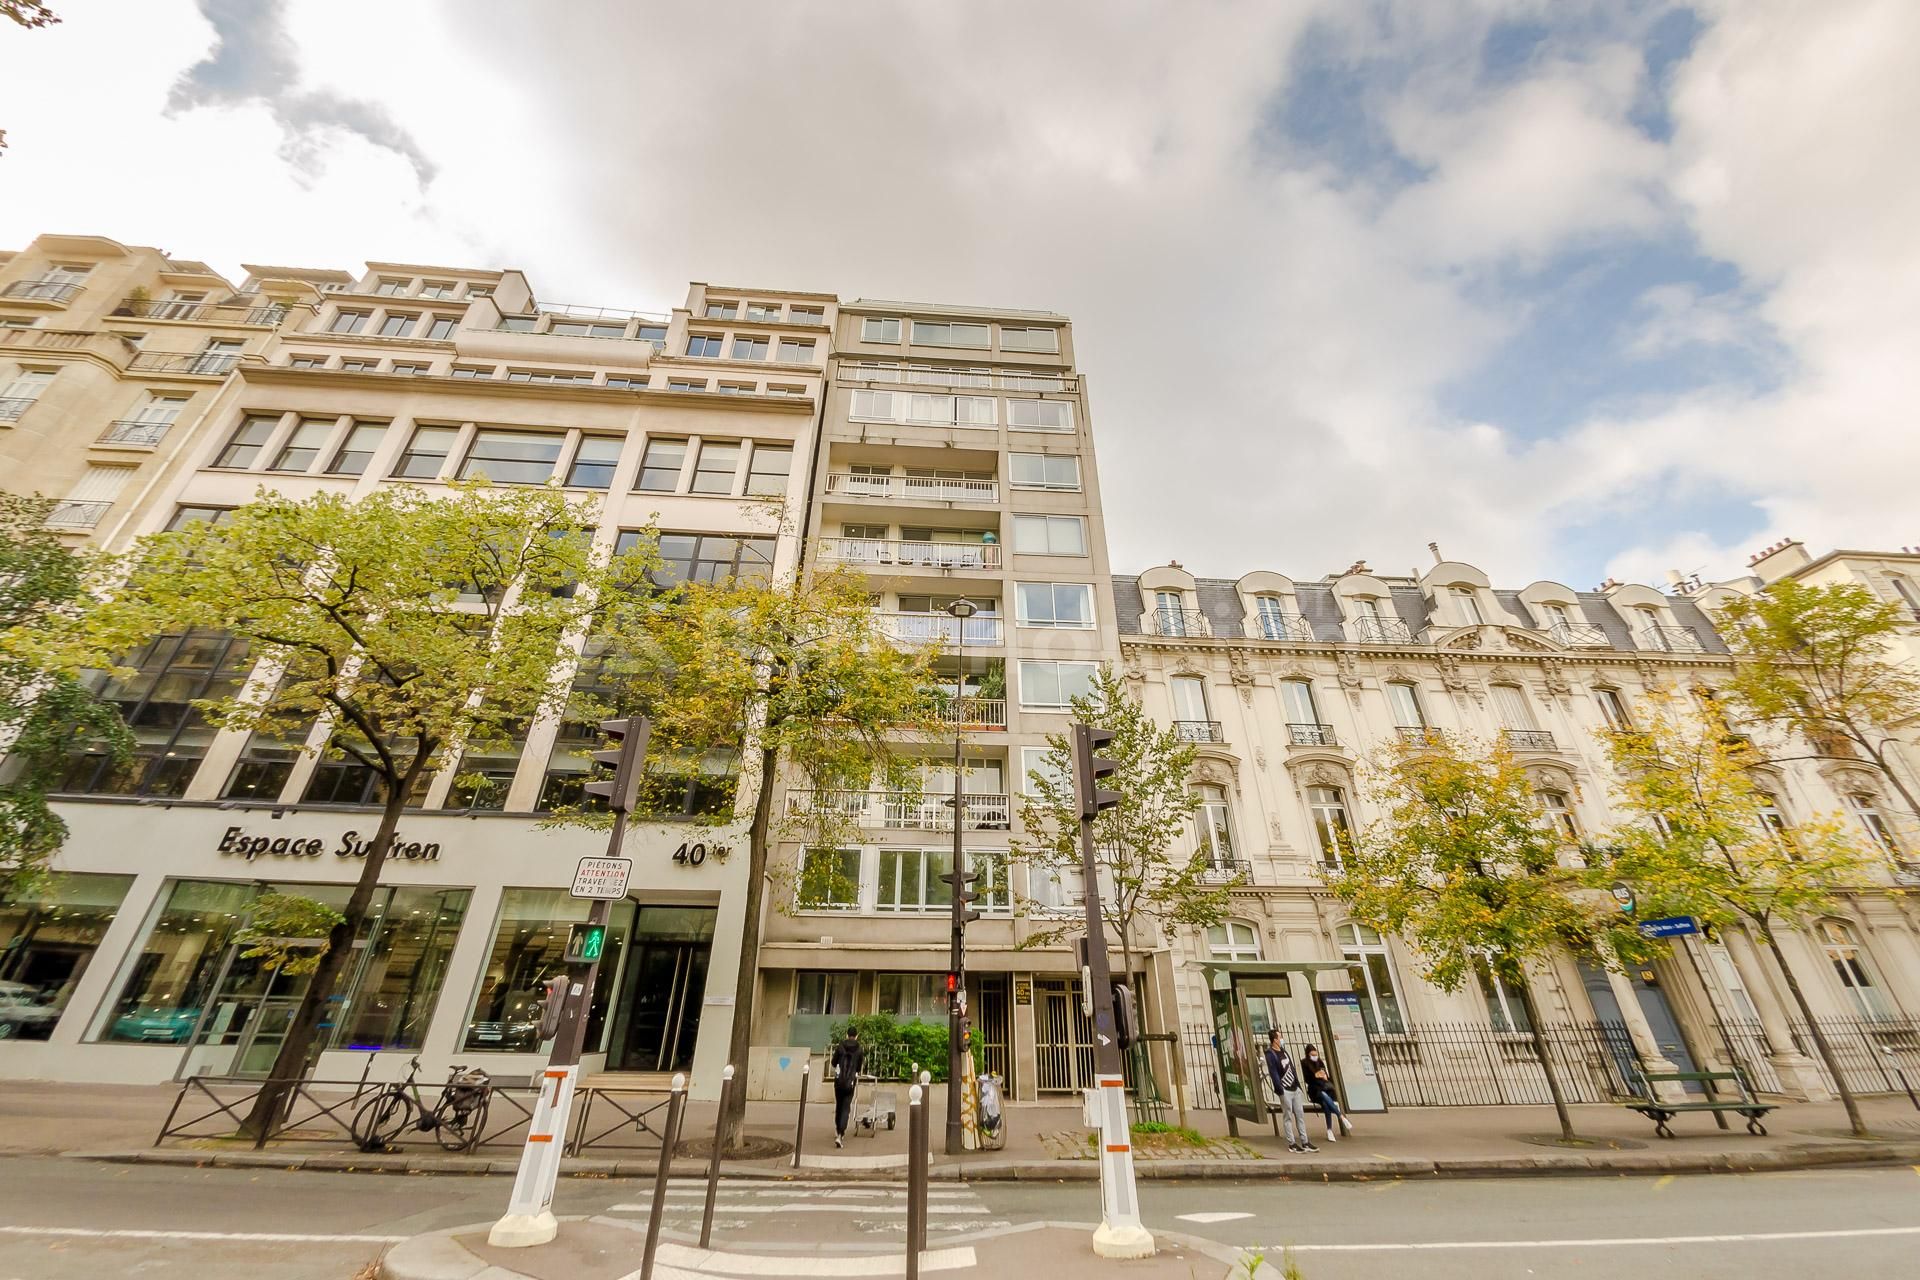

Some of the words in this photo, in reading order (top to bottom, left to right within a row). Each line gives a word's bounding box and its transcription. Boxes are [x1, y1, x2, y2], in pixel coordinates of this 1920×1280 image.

[217, 826, 323, 861] Espace
[334, 830, 441, 861] Suren
[672, 843, 706, 865] 40
[587, 860, 623, 870] PIÉTONS
[580, 869, 626, 878] ATTENTION
[578, 877, 624, 887] TRAVEEZ
[574, 885, 586, 893] EN
